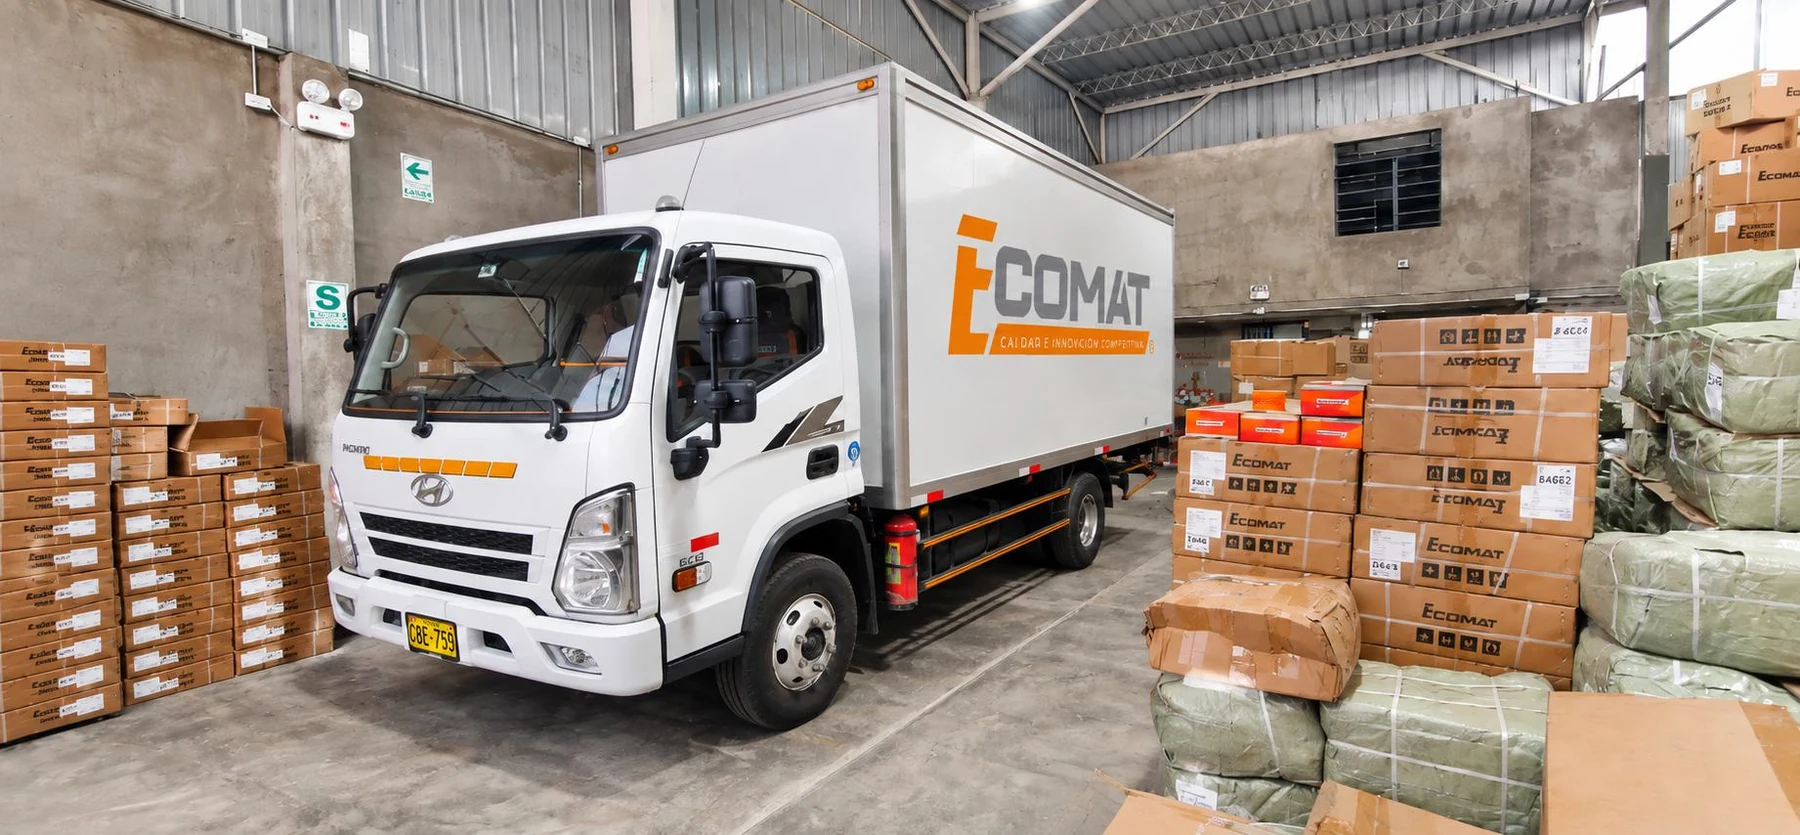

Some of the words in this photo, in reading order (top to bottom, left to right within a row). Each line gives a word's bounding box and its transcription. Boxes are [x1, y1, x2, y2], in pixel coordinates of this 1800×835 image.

[948, 214, 1150, 355] ECOMAT
[315, 285, 341, 310] S
[1231, 453, 1292, 471] ECOMAT
[1229, 512, 1286, 530] ECOMAT
[1426, 536, 1504, 560] ECOMAT
[1421, 602, 1498, 629] ECOMAT
